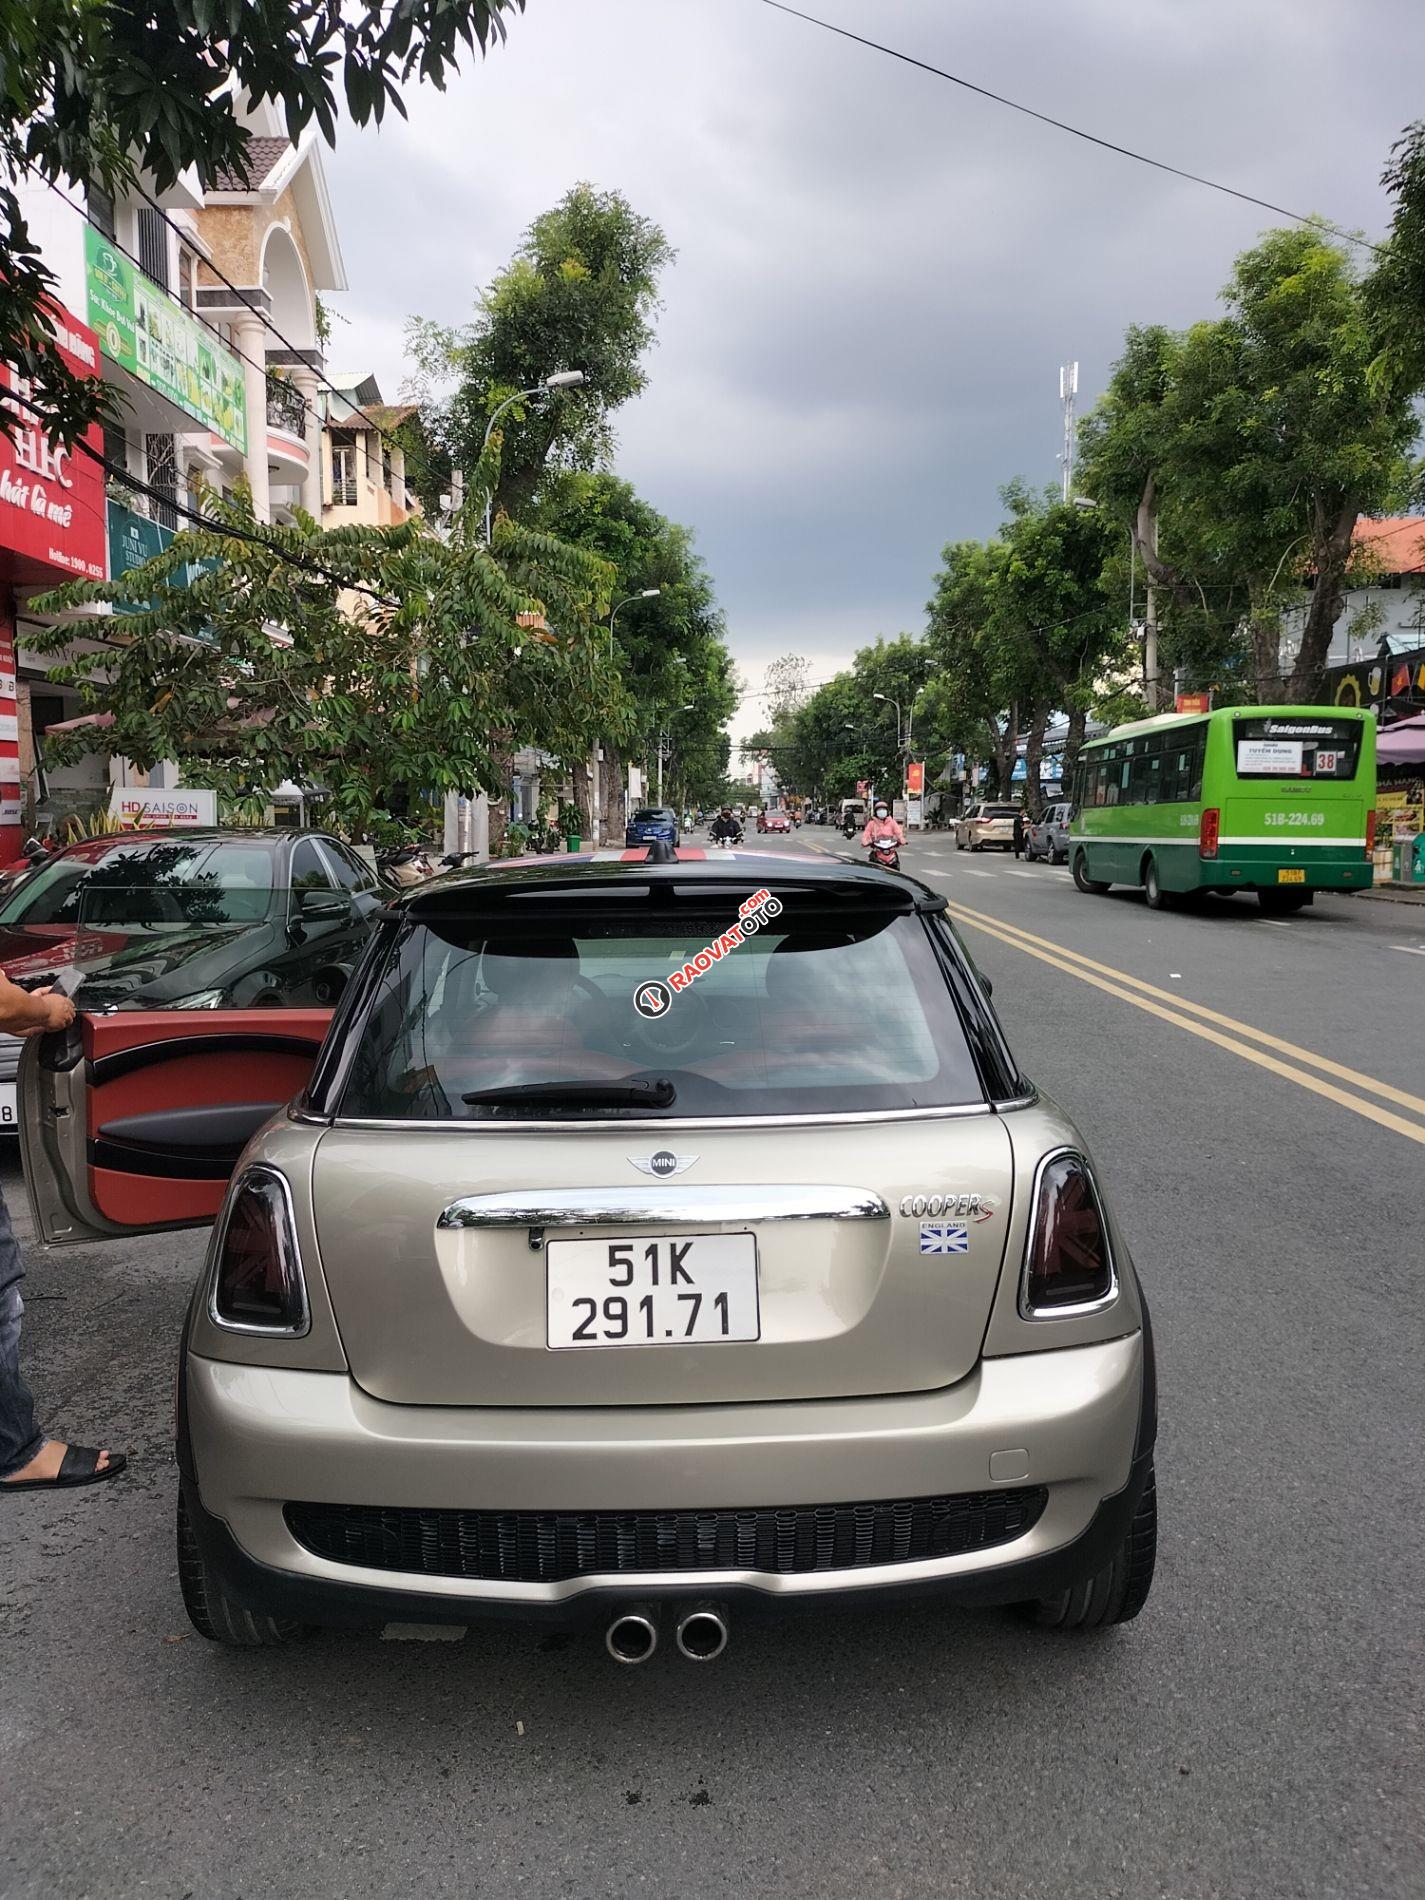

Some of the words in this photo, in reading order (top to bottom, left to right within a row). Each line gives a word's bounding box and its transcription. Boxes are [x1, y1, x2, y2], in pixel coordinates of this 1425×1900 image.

[47, 501, 73, 528] mê
[1269, 724, 1333, 735] SaigonBus
[1318, 754, 1336, 769] 38
[121, 801, 140, 812] HD
[143, 801, 199, 813] SAISON
[1264, 812, 1325, 826] 51B-224.69
[652, 1158, 676, 1167] MINI
[608, 1242, 695, 1287] 51K
[571, 1291, 730, 1341] 291.71
